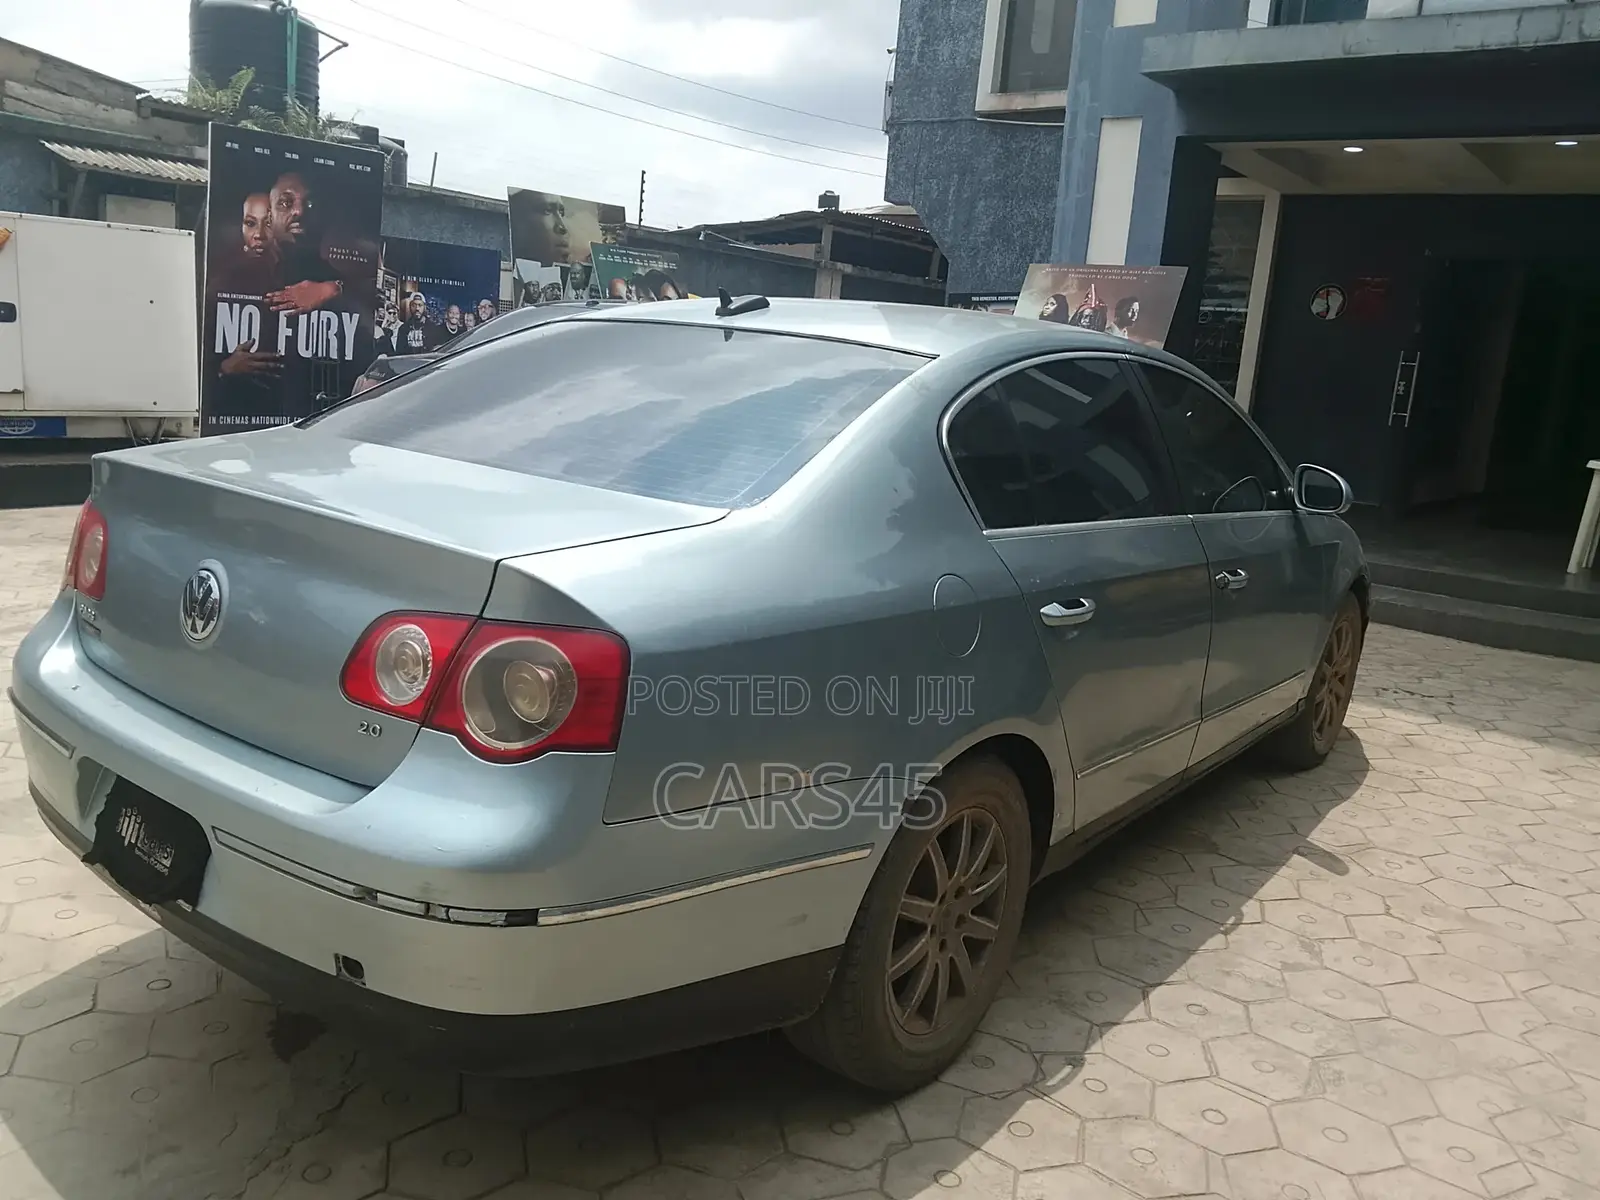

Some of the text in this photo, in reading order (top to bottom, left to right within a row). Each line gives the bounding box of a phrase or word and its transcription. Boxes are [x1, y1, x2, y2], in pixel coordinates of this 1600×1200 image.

[329, 253, 368, 263] EVERYTHING
[215, 302, 360, 361] NO FURY
[208, 416, 217, 425] IN
[219, 415, 249, 425] CINEMAS
[251, 416, 290, 425] NATIONWIDE
[357, 720, 382, 738] 2.0
